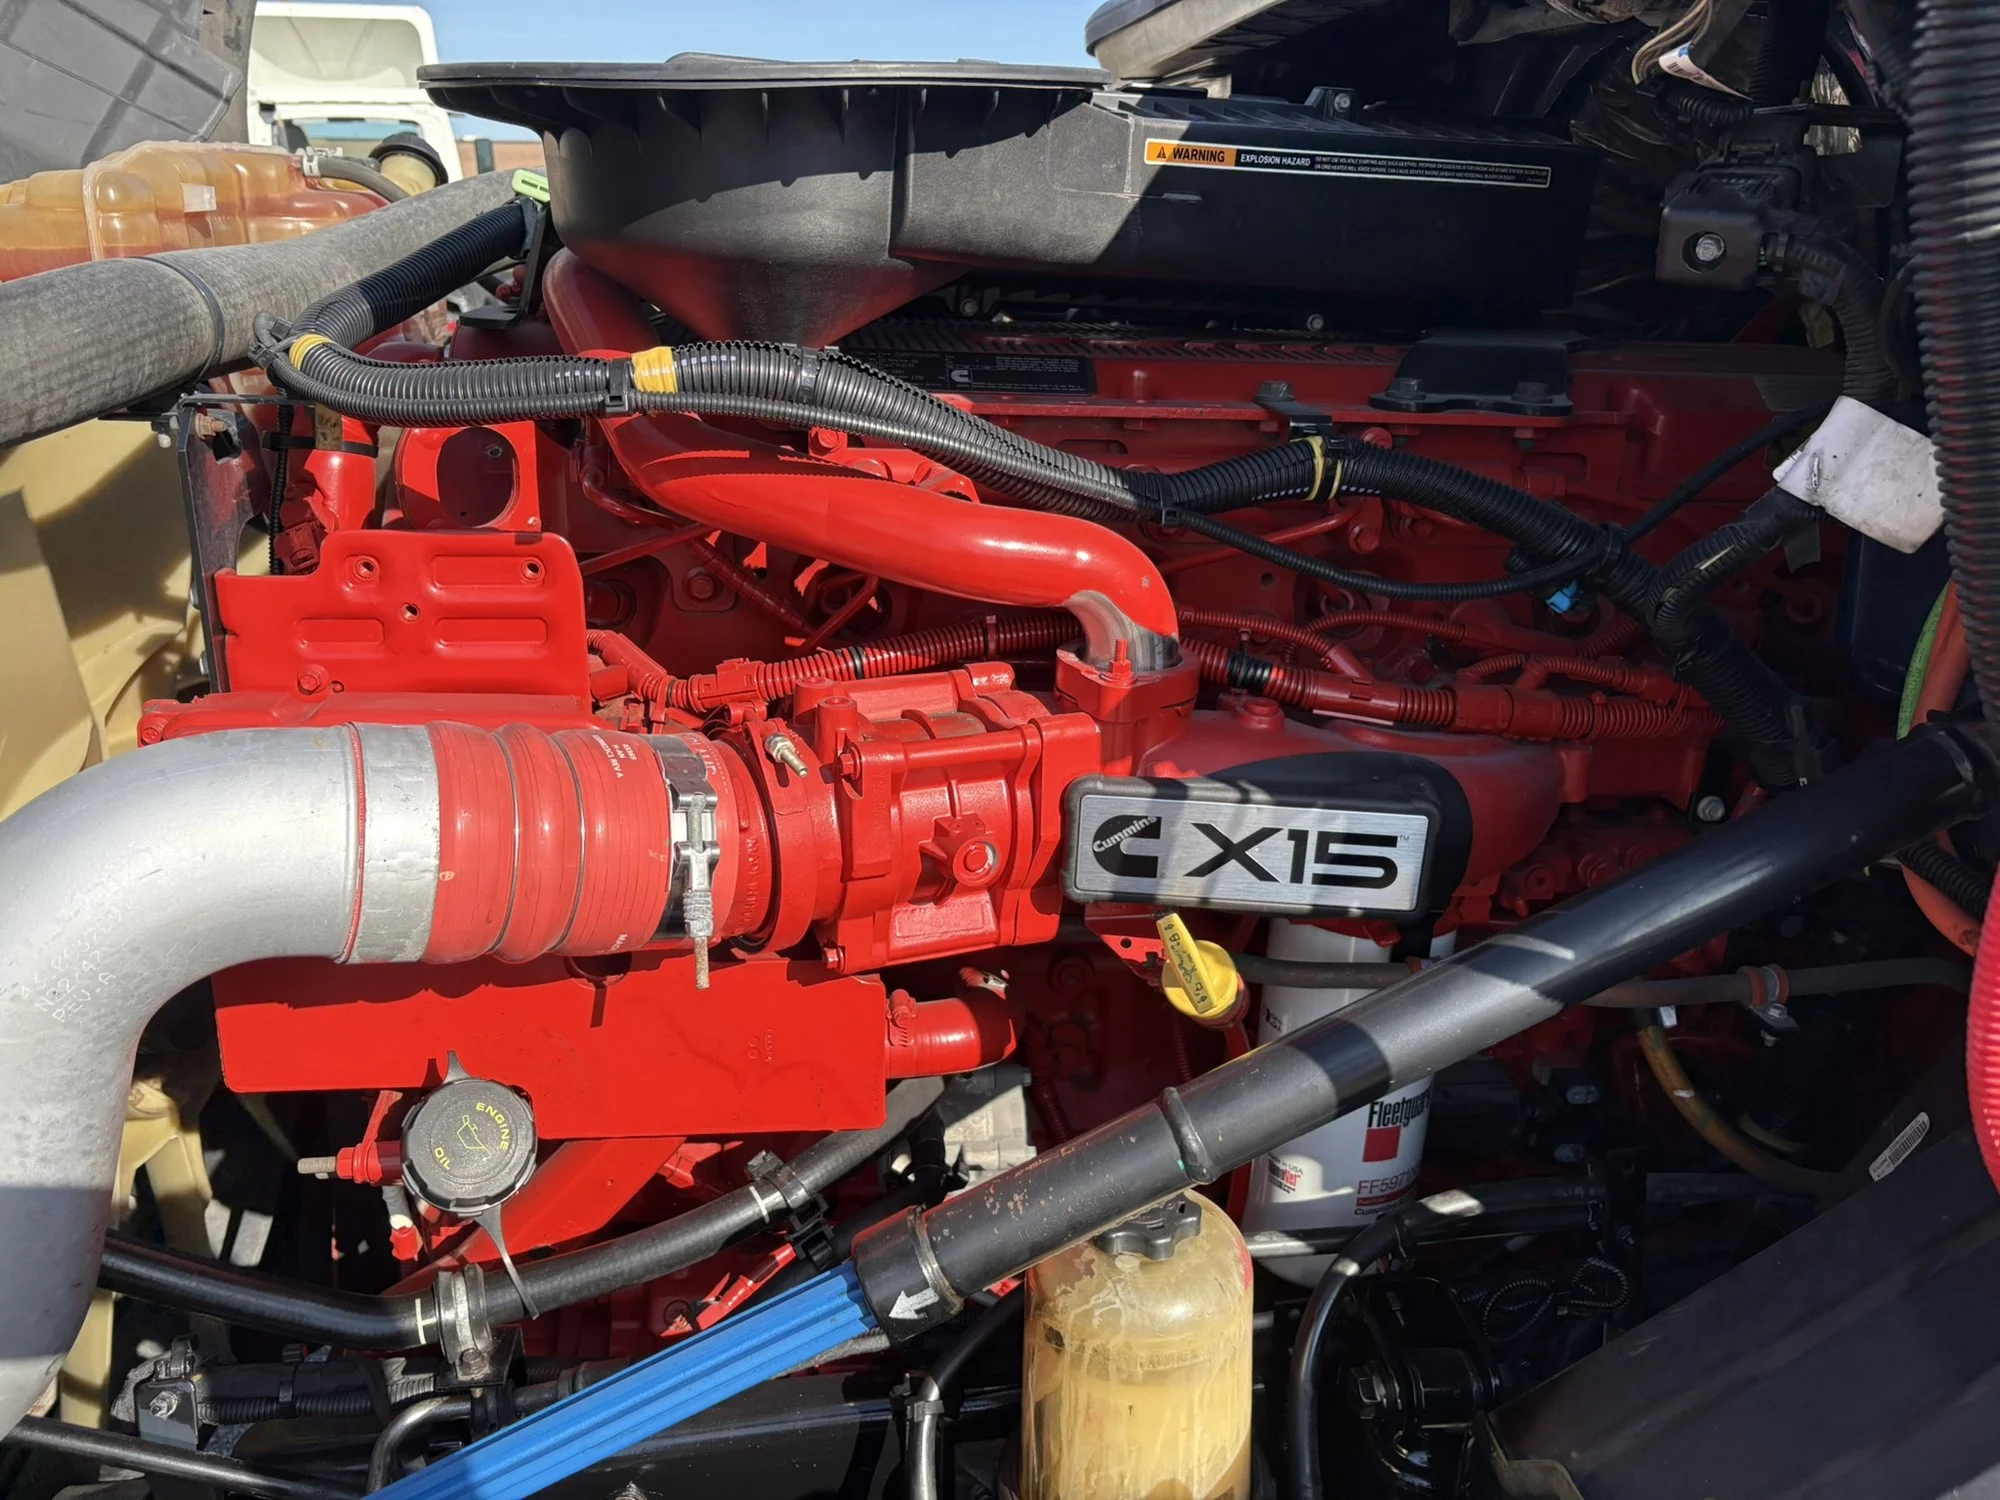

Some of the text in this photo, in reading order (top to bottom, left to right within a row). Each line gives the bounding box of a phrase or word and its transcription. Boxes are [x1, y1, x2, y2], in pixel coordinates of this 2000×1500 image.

[1172, 147, 1225, 163] WARNING
[1240, 153, 1311, 167] EXPLOSION HAZARD
[1092, 815, 1158, 853] Cummins
[1183, 822, 1399, 889] X15
[475, 1102, 511, 1151] ENGINE
[434, 1147, 451, 1171] OIL
[1289, 1163, 1304, 1175] USA
